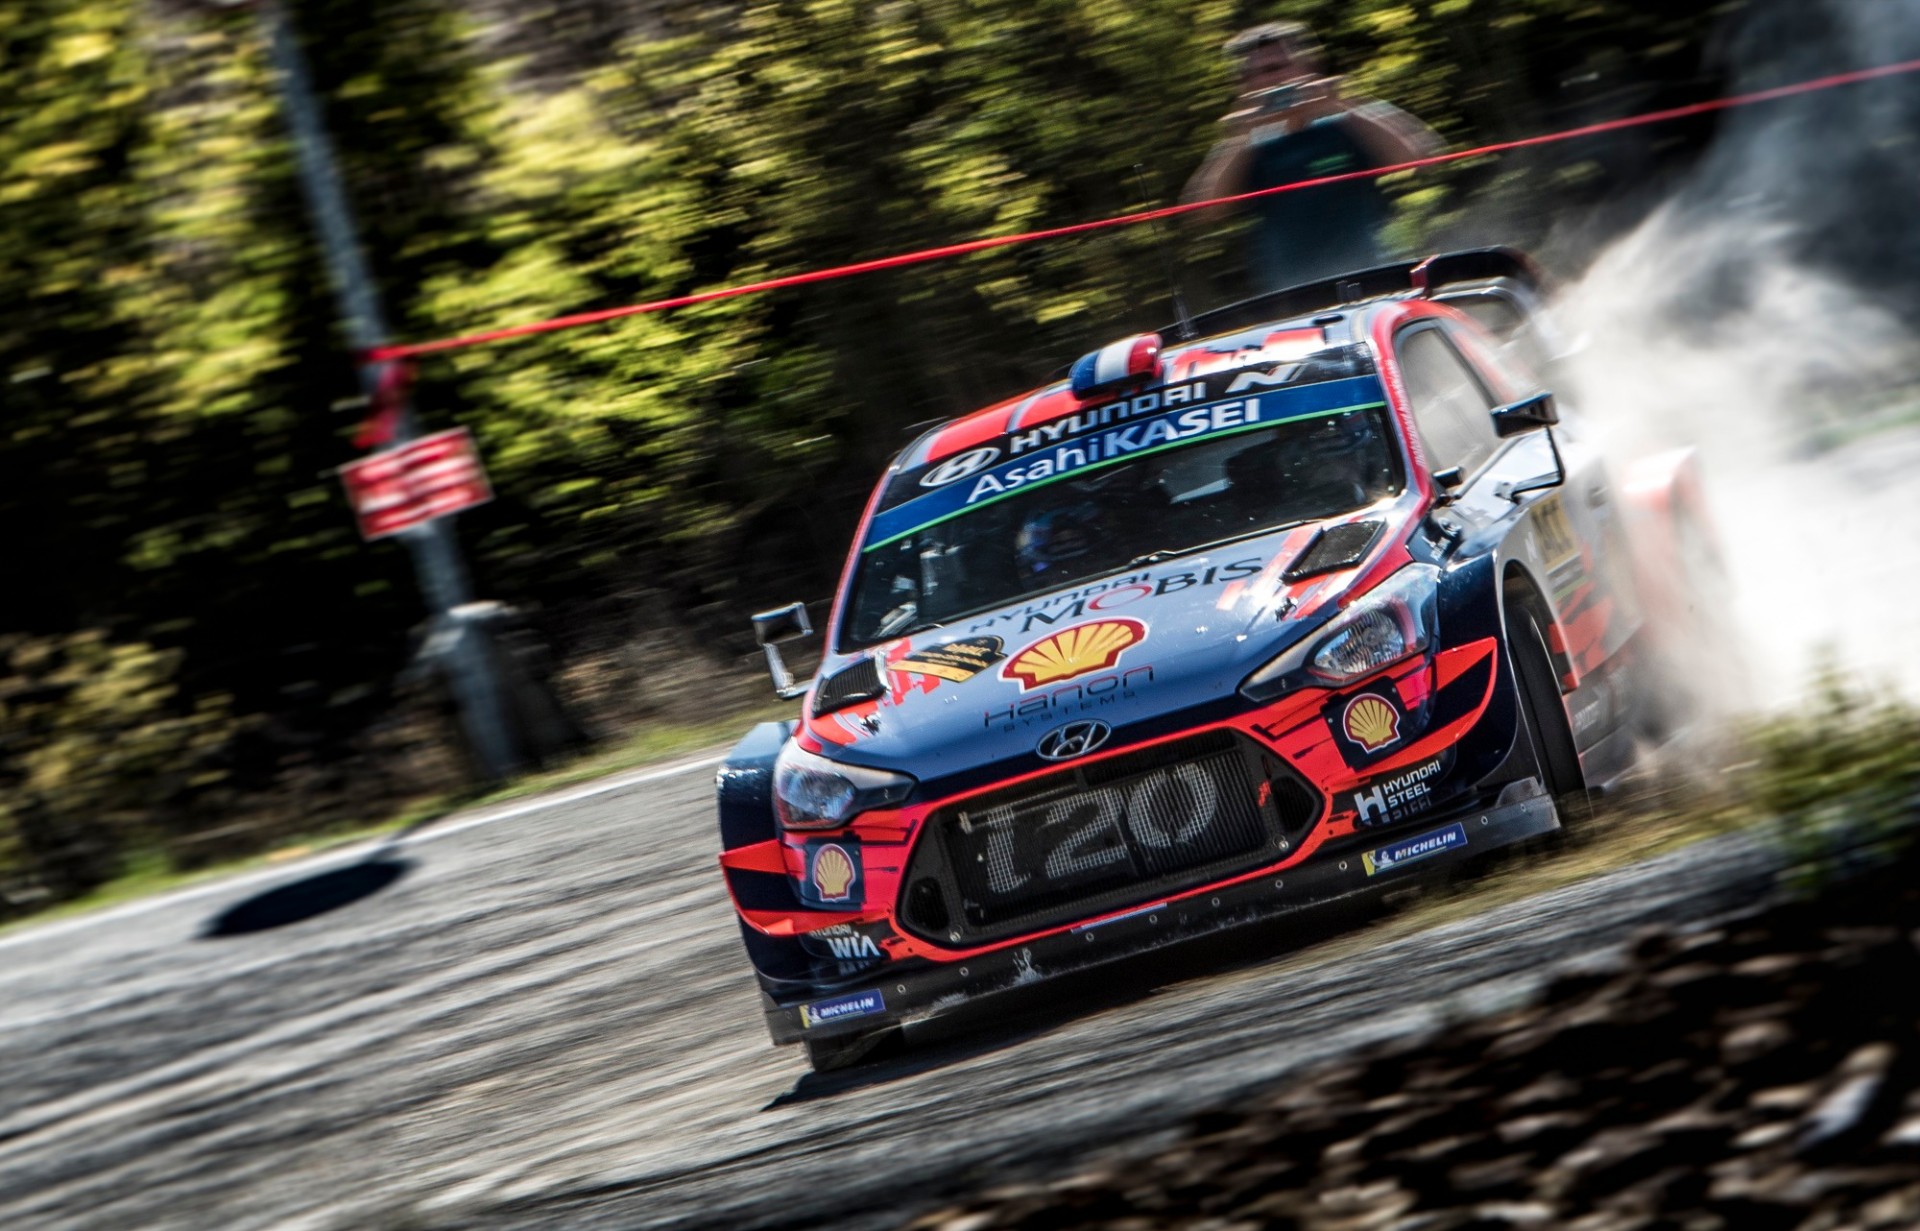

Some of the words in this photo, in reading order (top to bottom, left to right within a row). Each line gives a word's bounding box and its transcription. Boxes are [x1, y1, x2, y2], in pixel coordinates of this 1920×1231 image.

[1010, 381, 1207, 455] HYUNDAI
[969, 573, 1151, 633] HYUNDAI
[1020, 557, 1263, 634] MOBIS
[1003, 690, 1136, 733] SYSTEMS
[1382, 760, 1441, 795] HYUNDAI
[1387, 781, 1431, 808] STEEL
[1395, 831, 1457, 860] MICHELIN
[820, 997, 874, 1018] MICHELIN
